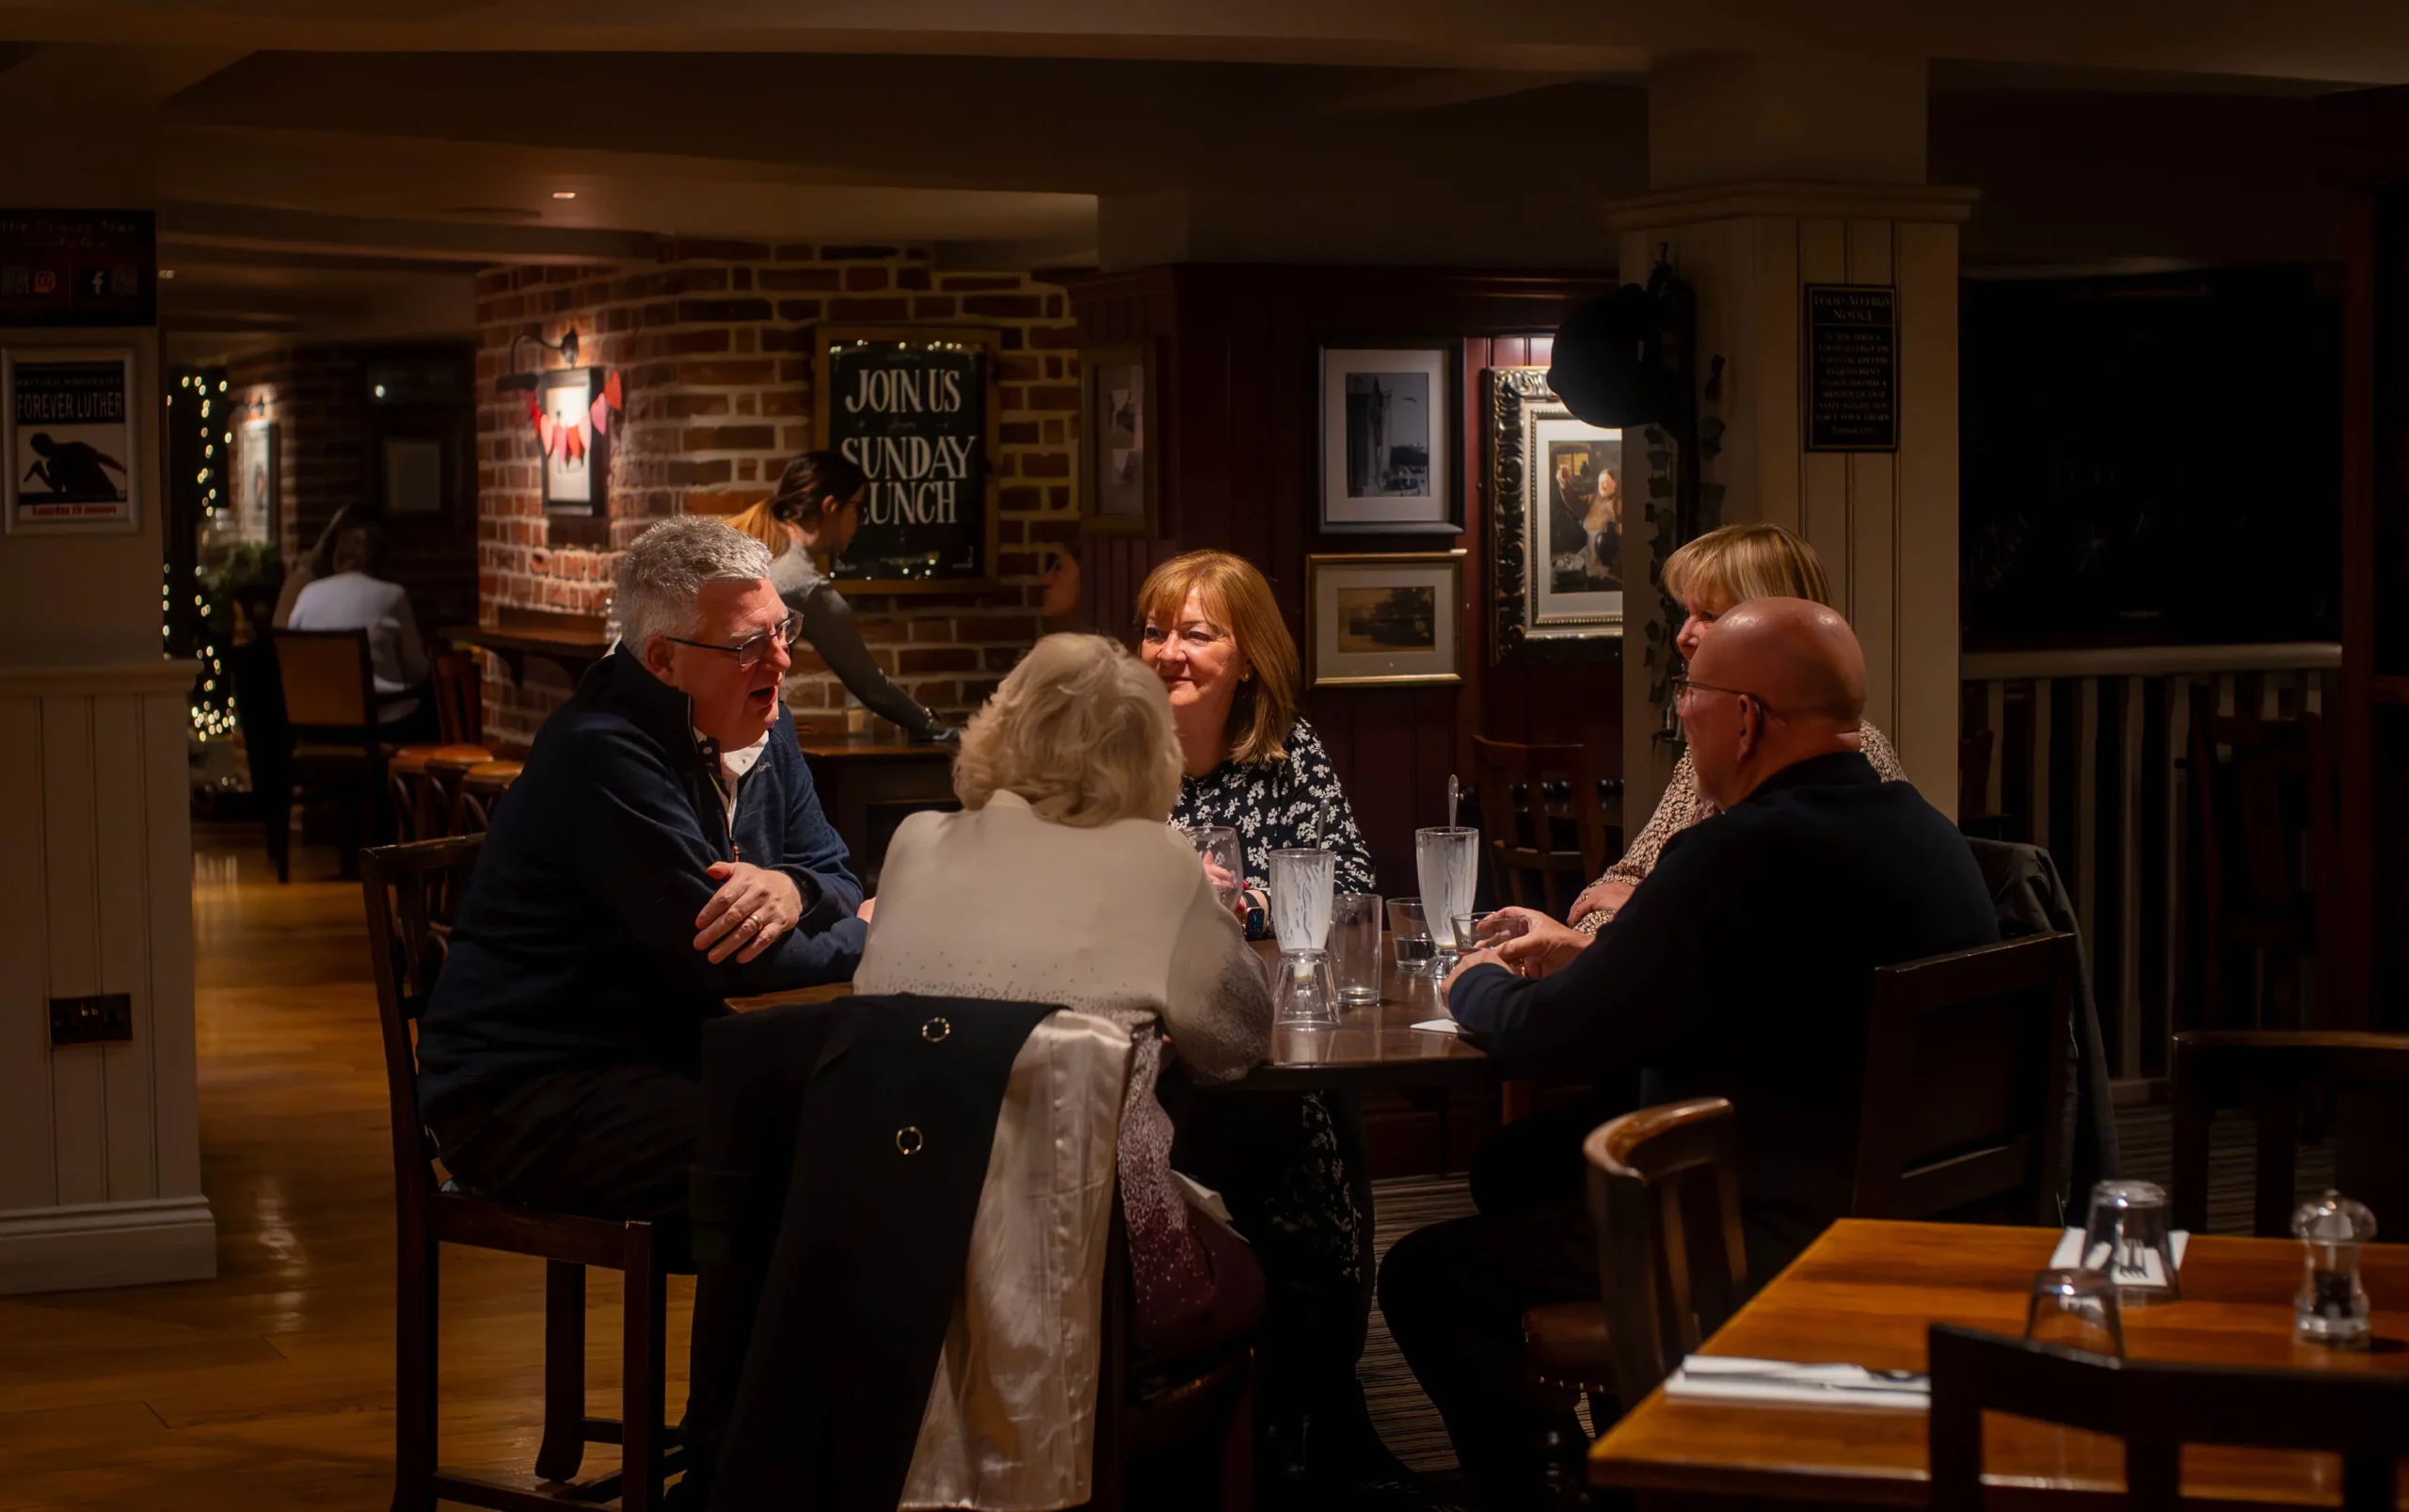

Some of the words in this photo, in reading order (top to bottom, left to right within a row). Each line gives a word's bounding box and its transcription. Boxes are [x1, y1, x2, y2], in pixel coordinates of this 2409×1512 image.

[17, 391, 73, 421] FOREVER
[77, 390, 123, 419] LUTHER
[845, 369, 925, 413] JOIN
[929, 368, 962, 413] US
[862, 480, 958, 525] UNCH
